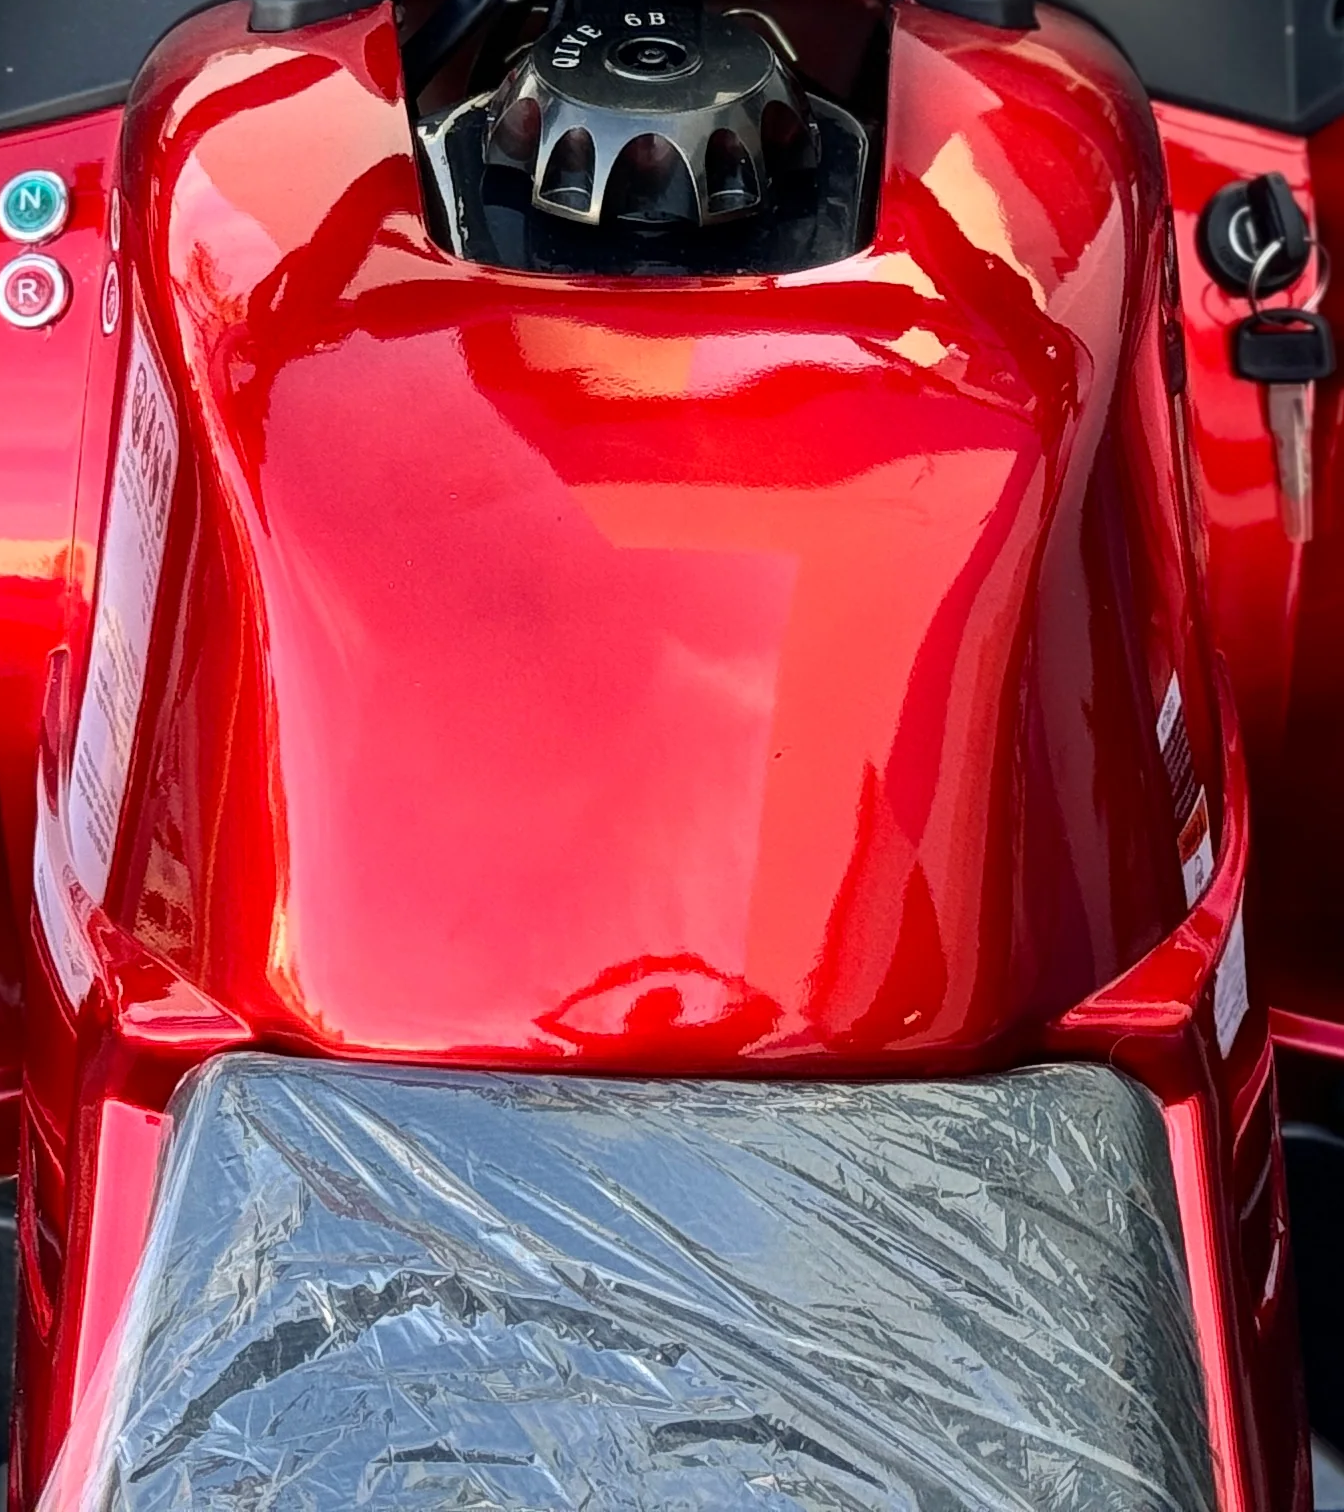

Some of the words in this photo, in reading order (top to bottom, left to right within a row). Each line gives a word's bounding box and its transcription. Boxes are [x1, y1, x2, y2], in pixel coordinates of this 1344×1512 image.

[552, 24, 603, 68] QIYE
[19, 186, 41, 210] N
[17, 278, 40, 304] R
